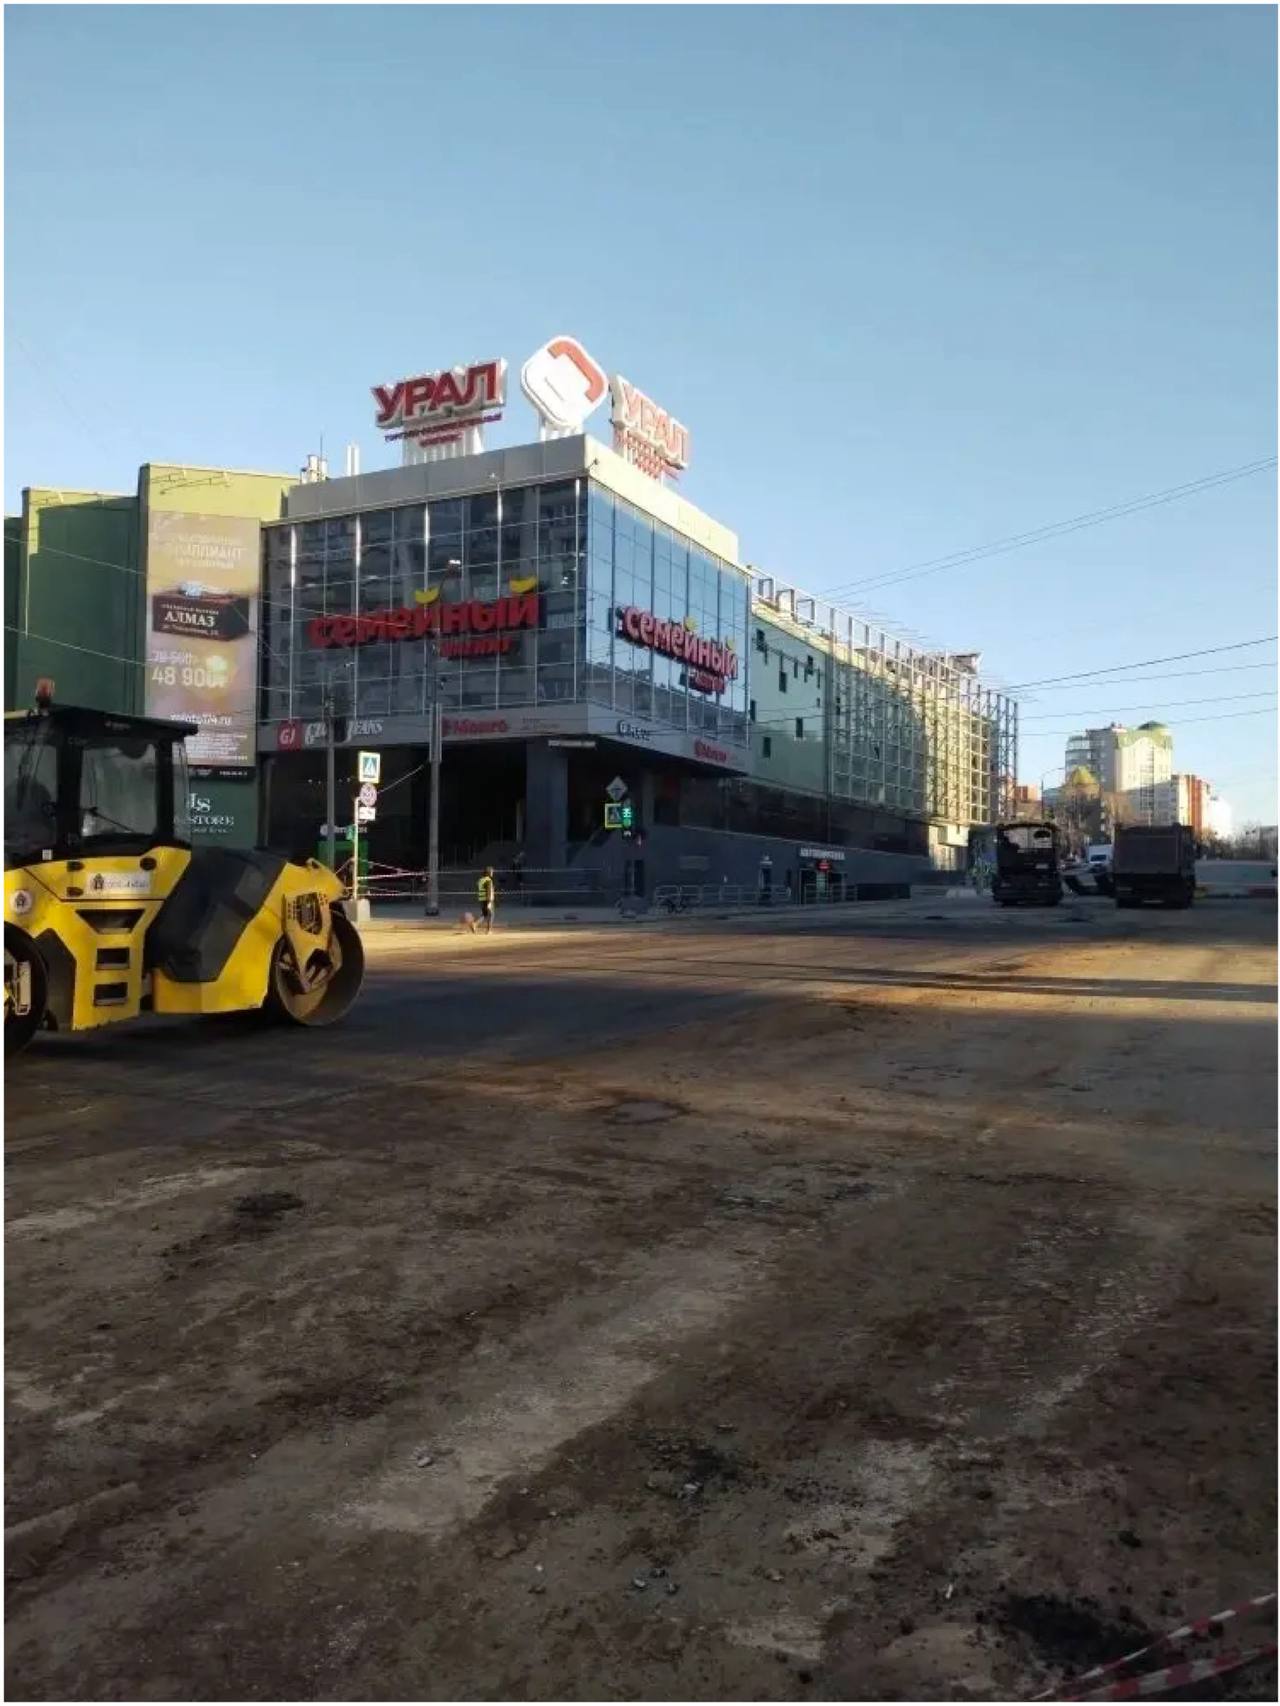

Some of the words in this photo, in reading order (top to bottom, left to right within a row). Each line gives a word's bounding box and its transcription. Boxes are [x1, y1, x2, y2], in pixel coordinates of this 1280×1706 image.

[373, 361, 499, 424] УРАЛ
[620, 380, 687, 465] УРАЛ
[164, 610, 215, 628] АЛМАЗ
[152, 667, 176, 686] 48
